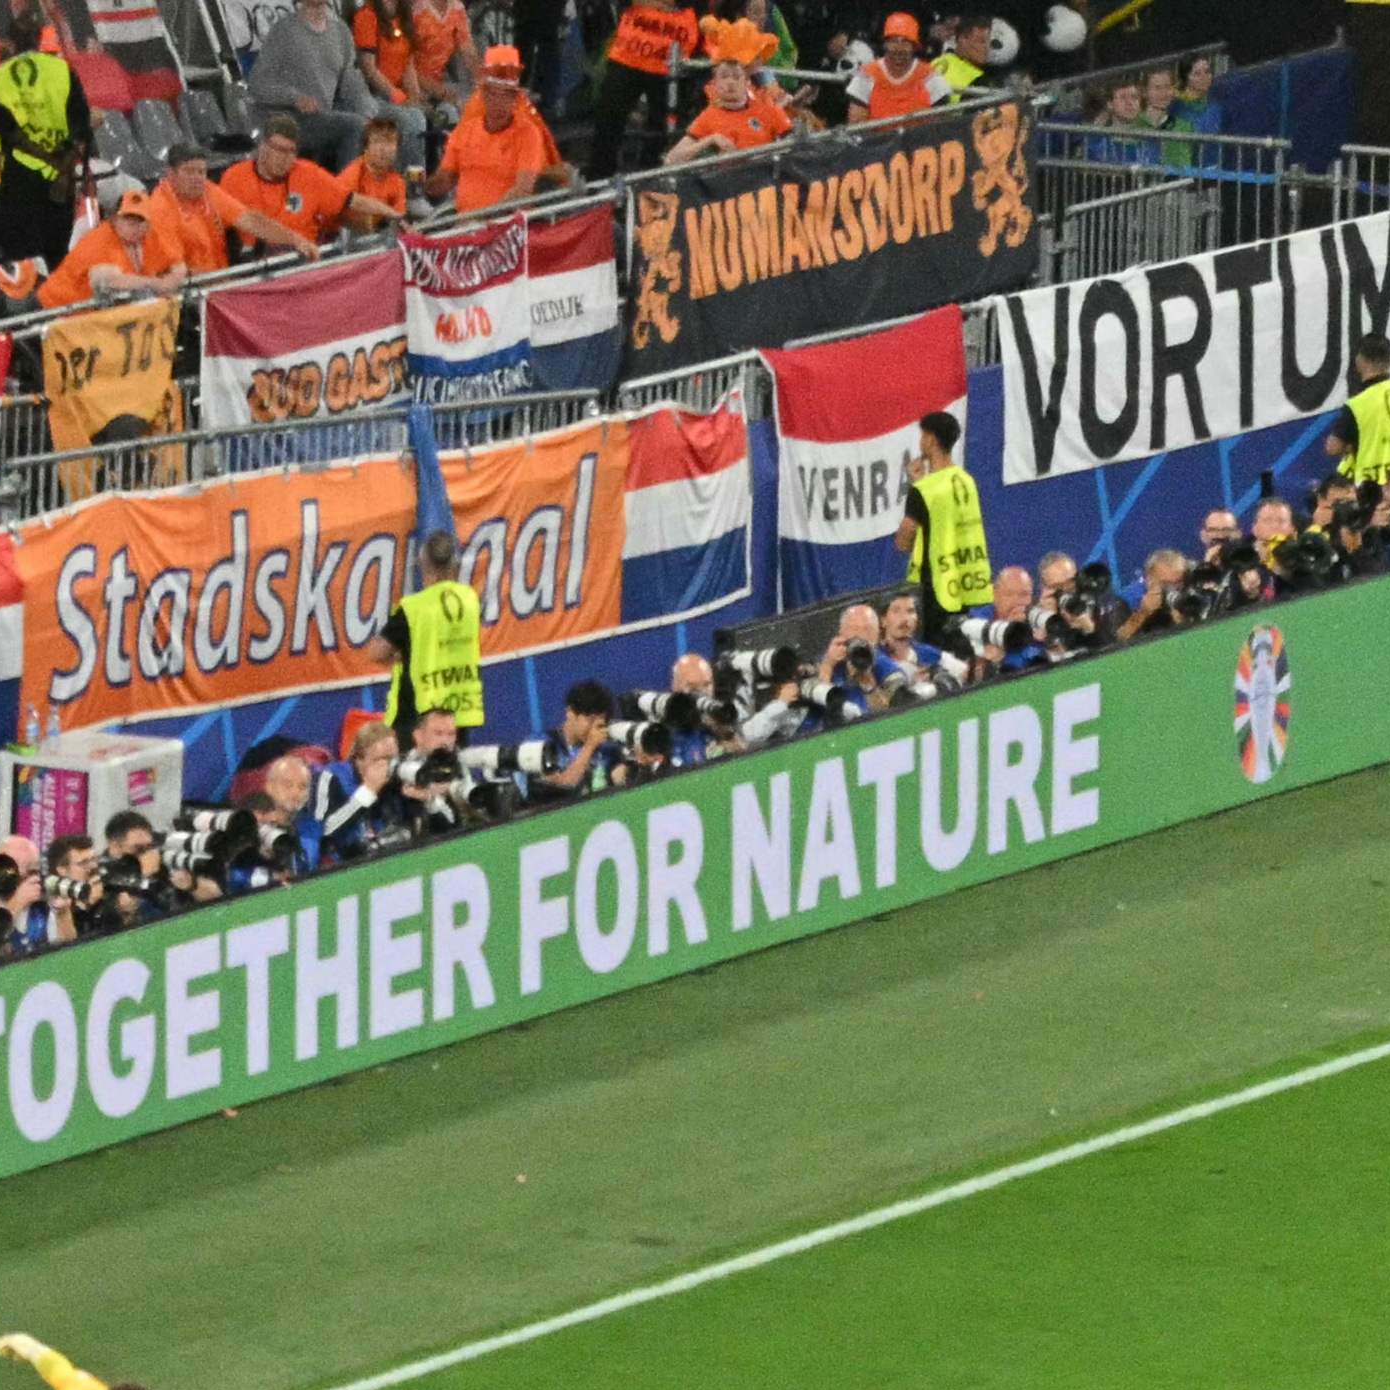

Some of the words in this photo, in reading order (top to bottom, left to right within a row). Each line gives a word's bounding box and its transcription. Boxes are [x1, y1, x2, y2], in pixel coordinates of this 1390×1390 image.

[685, 140, 965, 299] NUMANSDORP
[324, 334, 410, 414] GAST
[797, 448, 910, 522] VENRA
[48, 452, 599, 702] Stadskaaal
[519, 800, 708, 995] FOR
[731, 683, 1101, 932] NATURE
